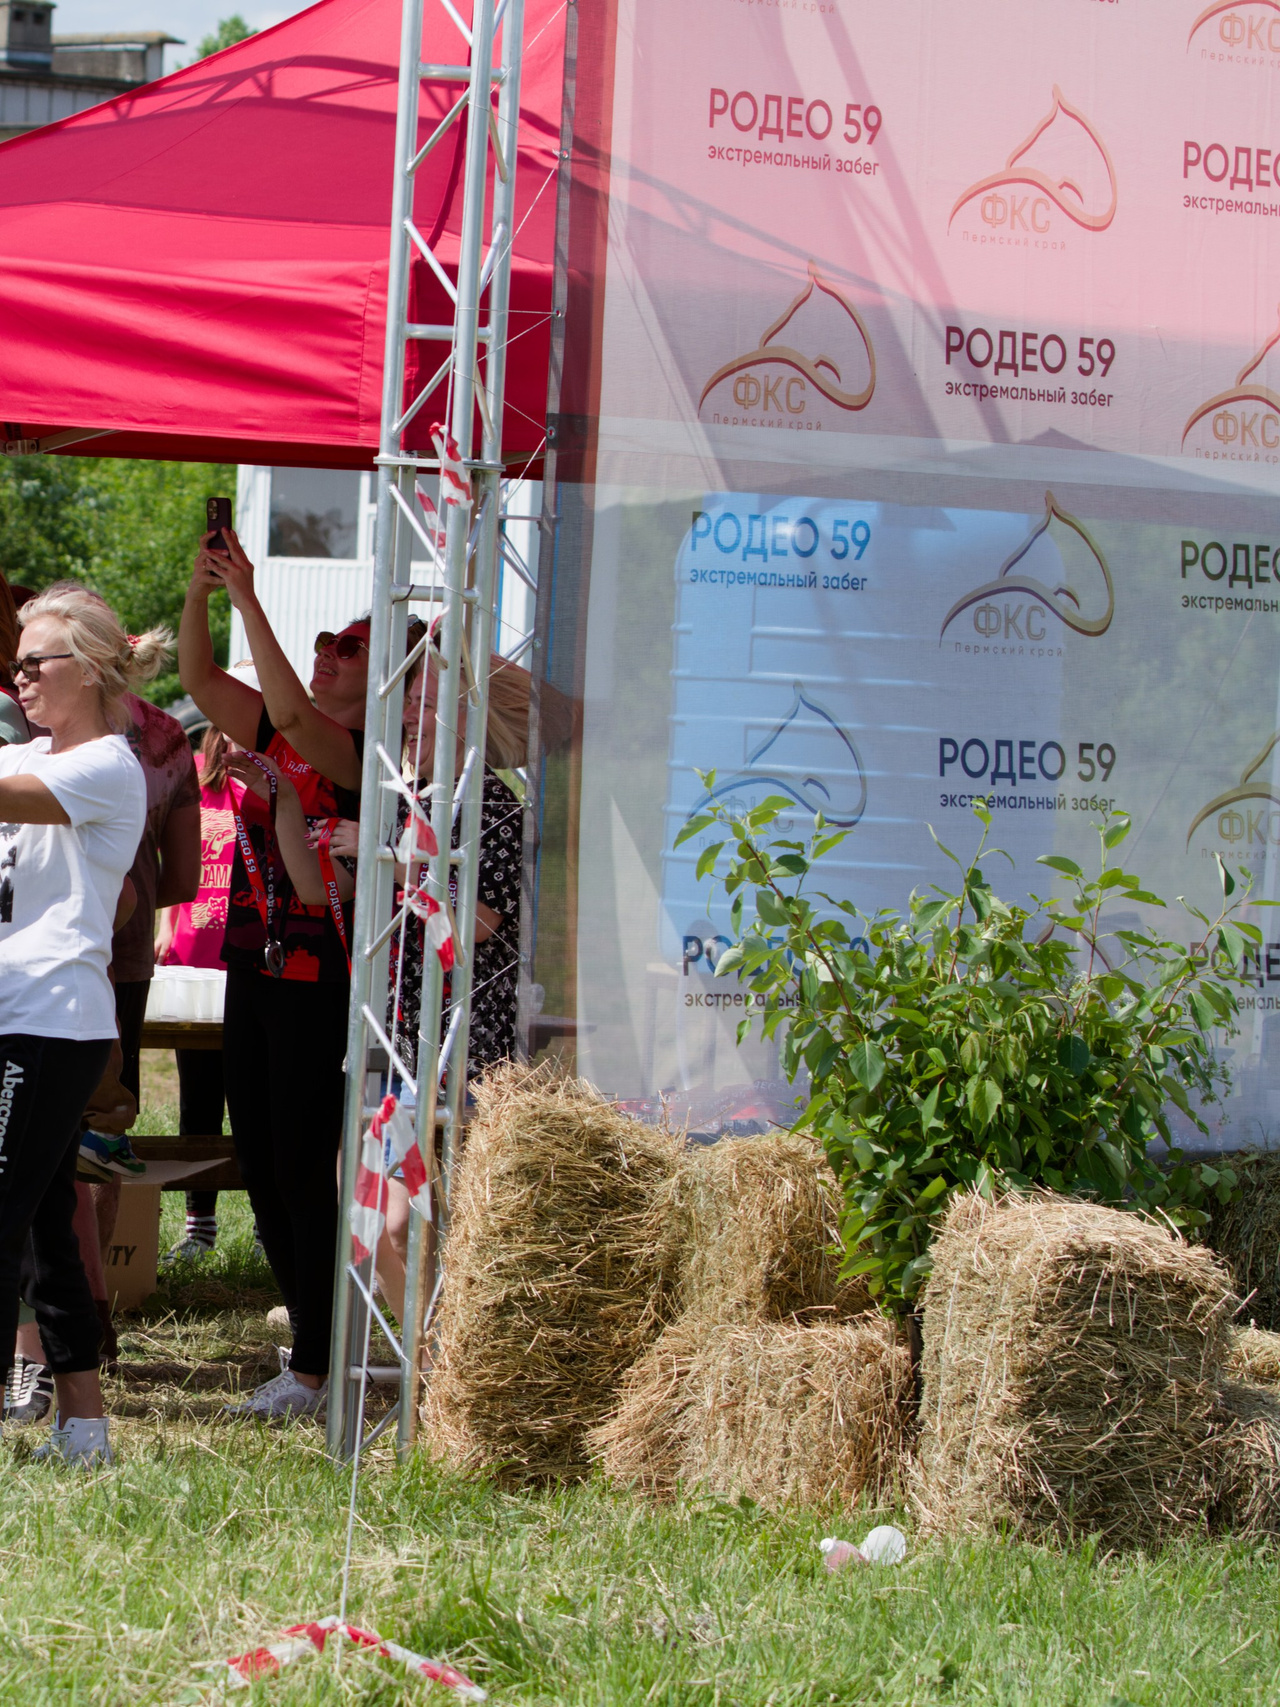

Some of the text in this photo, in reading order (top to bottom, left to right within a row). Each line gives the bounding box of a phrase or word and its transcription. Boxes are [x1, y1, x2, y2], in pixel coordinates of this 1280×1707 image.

[1201, 49, 1265, 66] Пермский
[709, 87, 883, 145] РОДЕО 59
[708, 145, 880, 176] экстремальный забег
[1183, 140, 1280, 193] РОДЕ
[980, 193, 1051, 234] ФКС
[1183, 194, 1280, 217] экстремальн
[962, 231, 1066, 251] Пермский край
[945, 325, 1116, 378] РОДЕО 59
[733, 373, 806, 414] ФКС
[945, 381, 1114, 407] экстремальный забег
[713, 413, 822, 432] Пермский край
[1212, 410, 1280, 449] ФКС
[1196, 447, 1260, 462] Пермский
[690, 511, 871, 563] РОДЕО 59
[690, 568, 868, 591] экстремальный забег
[1181, 594, 1280, 614] экстремальн
[973, 602, 1046, 641] ФКС
[955, 642, 1063, 658] Пермский край
[939, 737, 1117, 787] РОДЕО 59
[939, 793, 1116, 812] экстремальный забег
[234, 815, 257, 874] РОДЕО 59
[328, 881, 343, 919] РОДЕО
